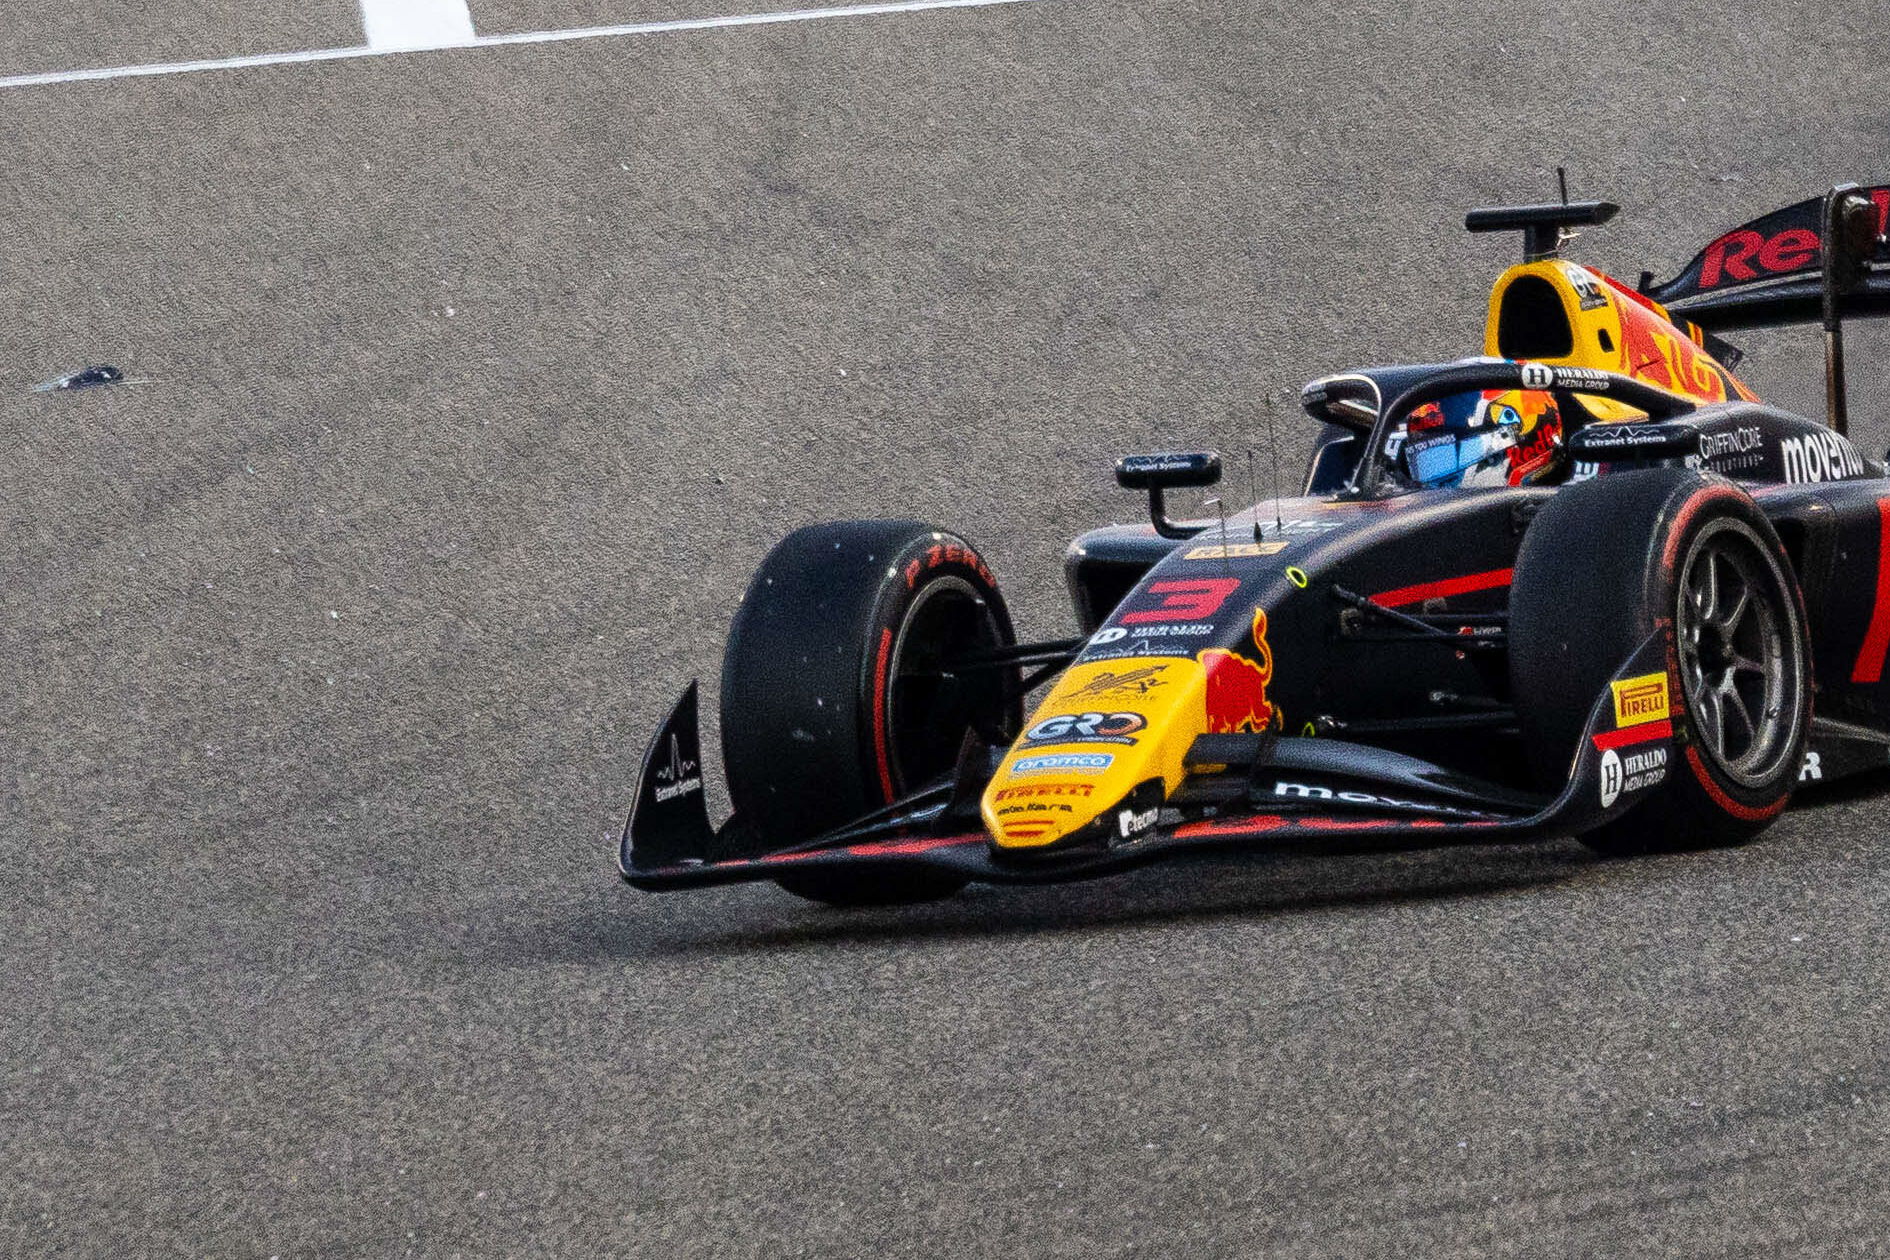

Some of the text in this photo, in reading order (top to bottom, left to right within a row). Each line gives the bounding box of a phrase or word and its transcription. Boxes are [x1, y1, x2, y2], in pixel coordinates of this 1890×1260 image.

[1558, 379, 1610, 390] MEDIA GROUP
[1585, 434, 1667, 448] Extranet Systems
[1700, 427, 1763, 460] GRIFFINCORE
[926, 543, 997, 589] ZERO
[1119, 577, 1242, 625] 3
[1621, 682, 1665, 719] PIRELLI
[1017, 754, 1108, 771] aramco
[1624, 748, 1668, 775] HERALDO
[994, 782, 1096, 803] PIRELLI
[1624, 768, 1666, 793] MEDIA GROUP
